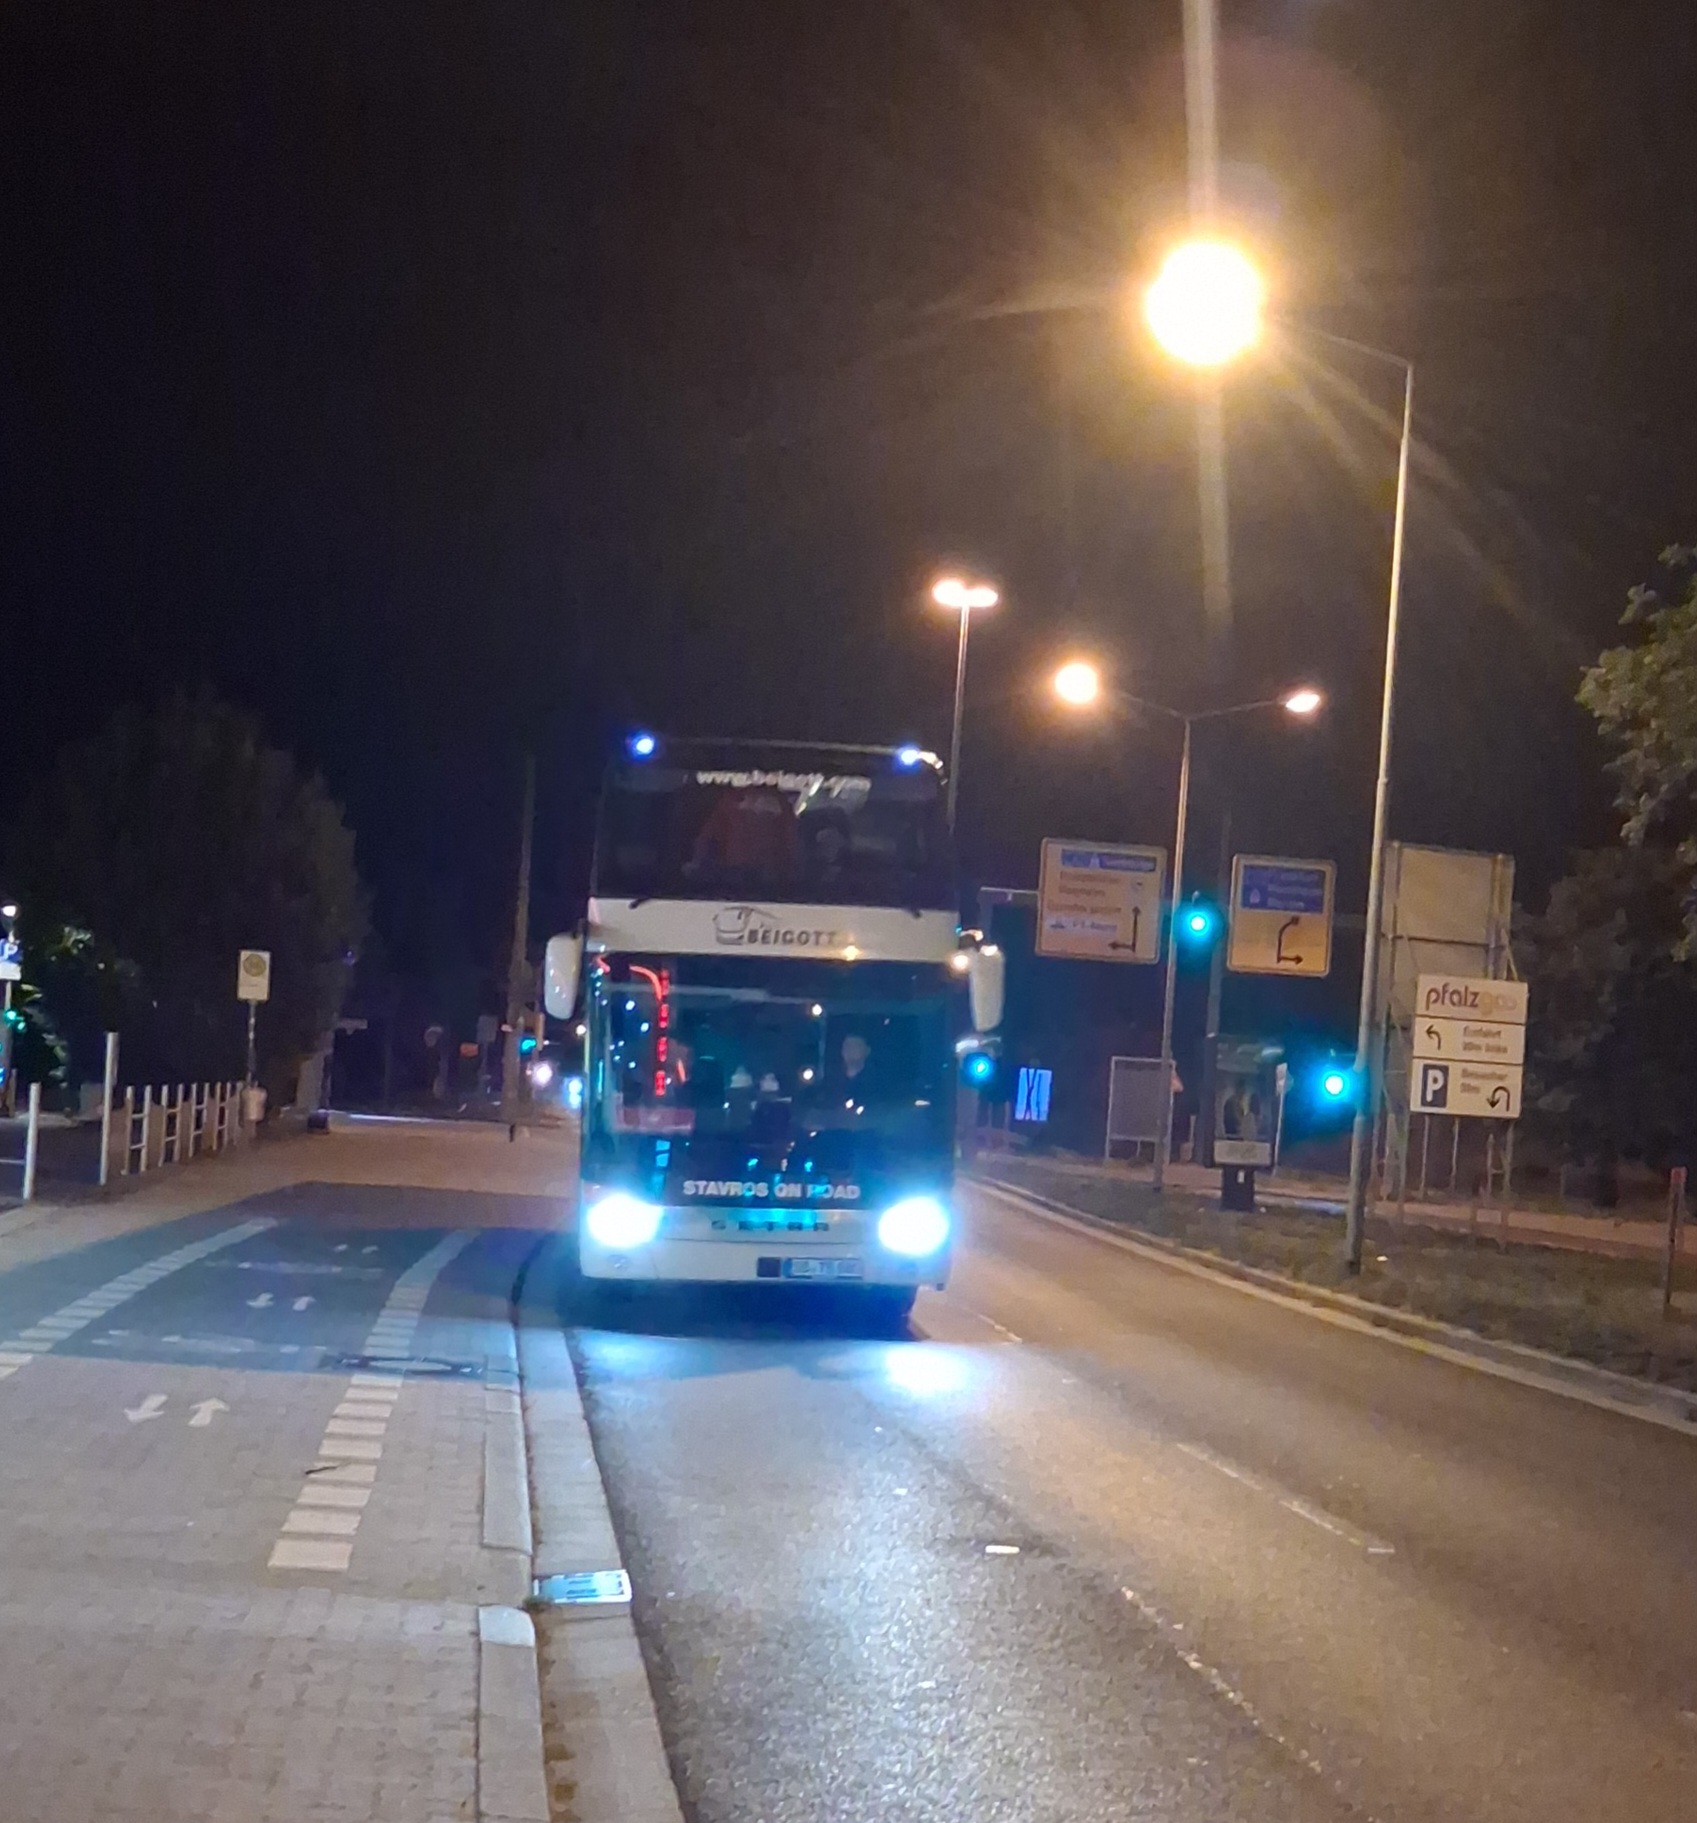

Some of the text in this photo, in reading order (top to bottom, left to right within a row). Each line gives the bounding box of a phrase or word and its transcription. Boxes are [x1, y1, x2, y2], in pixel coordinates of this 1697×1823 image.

[1425, 1068, 1445, 1103] P
[682, 1179, 769, 1198] STAVROS
[774, 1181, 802, 1198] ON
